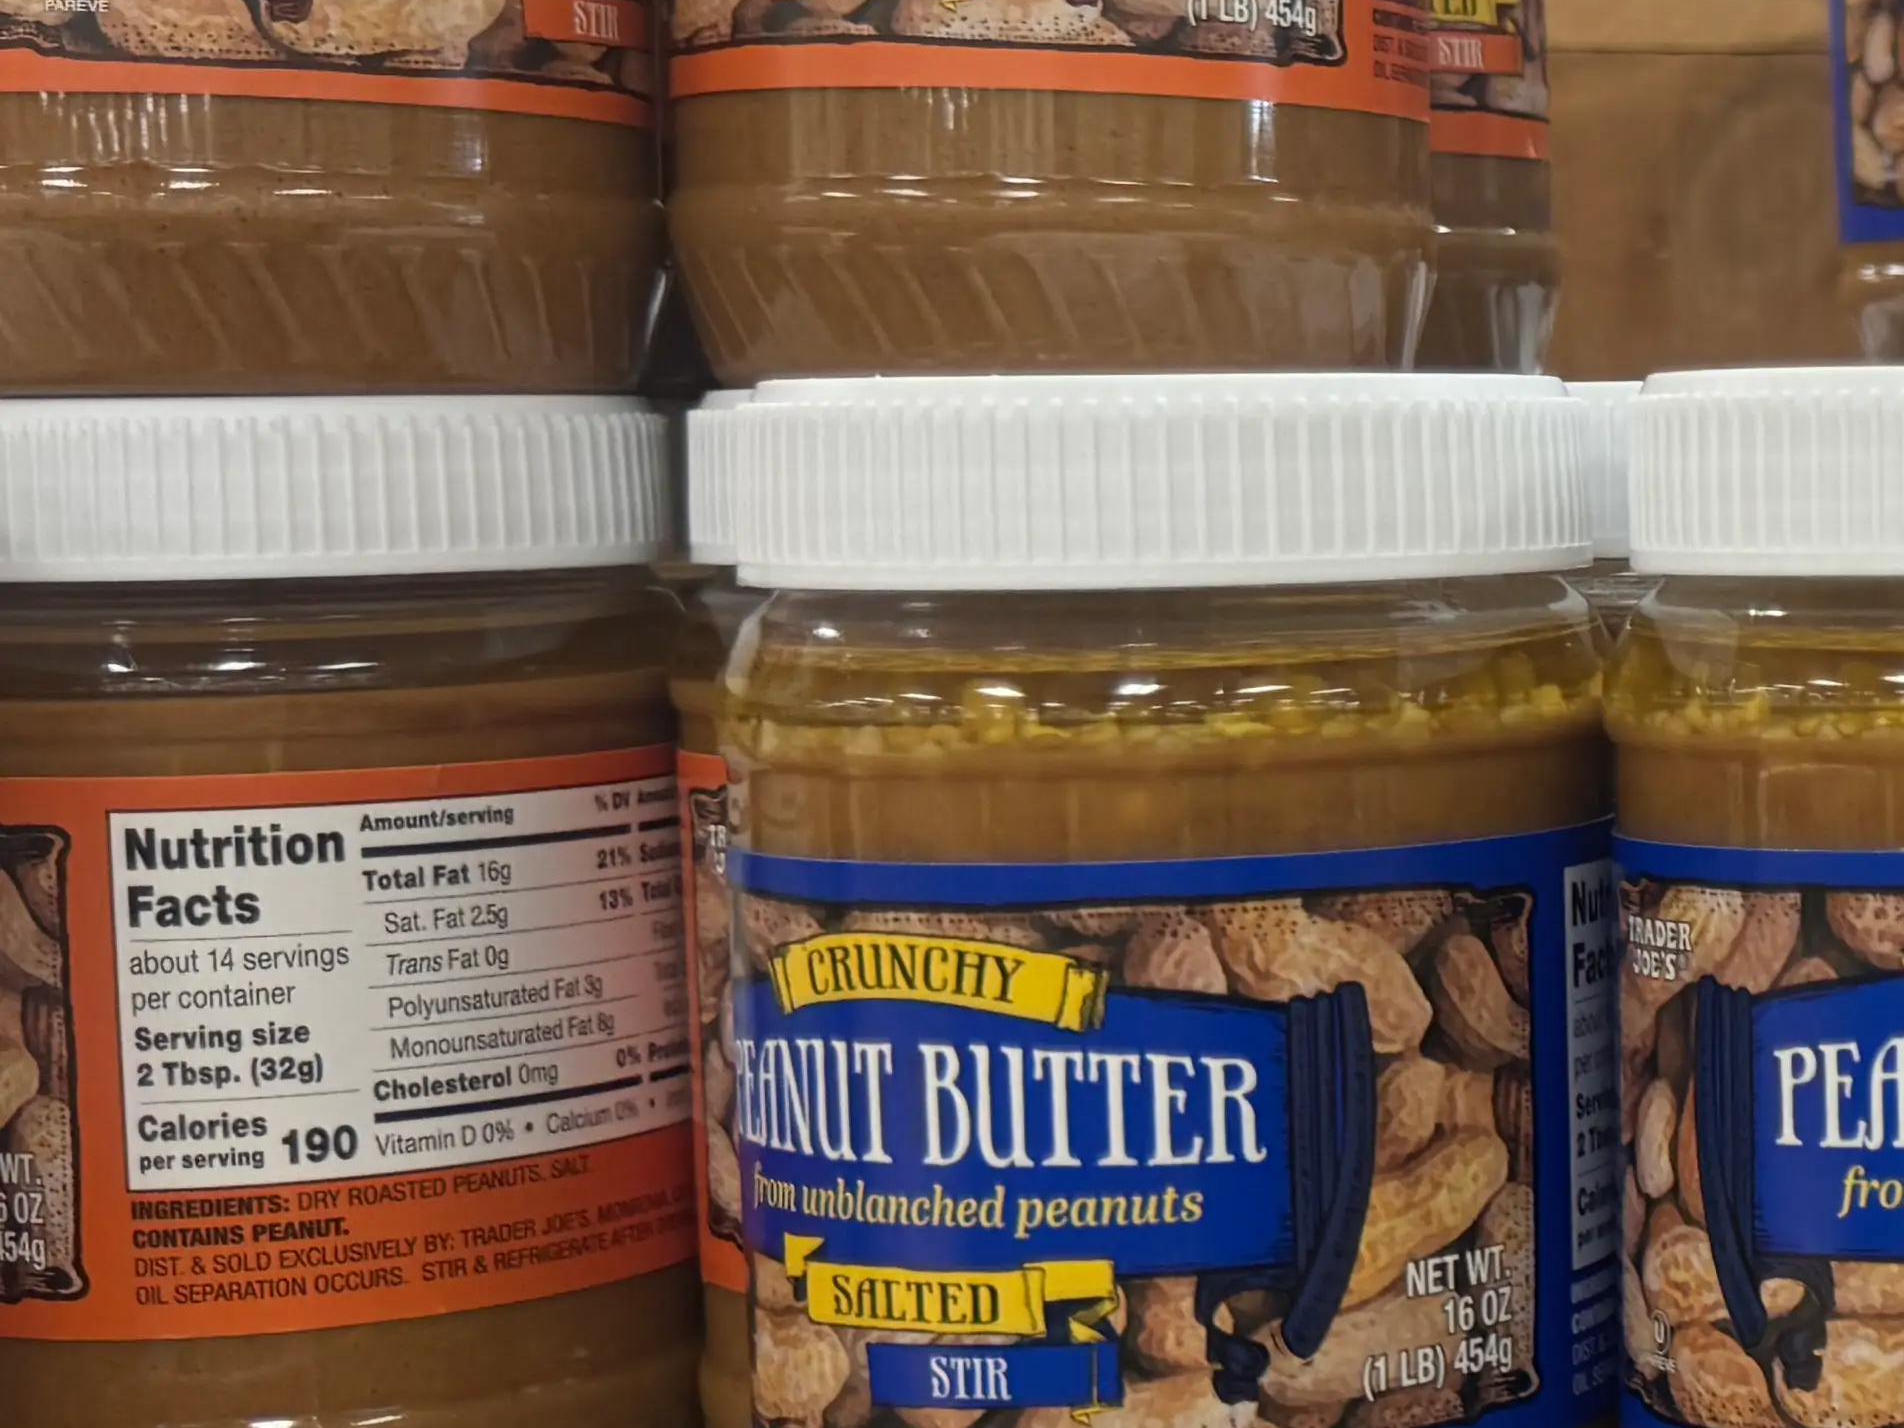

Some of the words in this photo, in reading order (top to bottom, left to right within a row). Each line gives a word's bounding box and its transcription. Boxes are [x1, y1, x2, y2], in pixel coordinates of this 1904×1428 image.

[571, 0, 620, 41] STIR
[359, 805, 515, 834] Amount/serving
[124, 827, 346, 872] Nutrition
[362, 863, 425, 891] Total
[432, 861, 470, 887] Fat
[477, 861, 512, 888] 16g
[127, 886, 261, 929] Facts
[1626, 916, 1692, 953] TRADER
[128, 946, 200, 977] about
[208, 947, 233, 972] 14
[243, 944, 350, 972] servings
[807, 944, 1025, 1005] CRUNCHY
[132, 988, 170, 1017] per
[177, 984, 296, 1011] container
[134, 1026, 243, 1054] Serving
[251, 1022, 311, 1046] size
[137, 1064, 154, 1087] 2
[161, 1059, 240, 1091] Tbsp.
[251, 1053, 323, 1085] (32g)
[373, 1065, 512, 1102] Cholesterol
[921, 1041, 1267, 1169] BUTTER
[138, 1111, 268, 1143] Calories
[281, 1125, 359, 1163] 190
[139, 1151, 175, 1173] per
[182, 1146, 265, 1170] serving
[801, 1178, 1006, 1230] unblanched
[1015, 1185, 1203, 1239] peanuts
[1407, 1255, 1459, 1297] NET
[1465, 1244, 1512, 1283] WT.
[831, 1274, 1001, 1327] SALTED
[1442, 1300, 1475, 1331] 16
[1481, 1293, 1513, 1326] OZ
[929, 1356, 1011, 1400] STIR
[1362, 1353, 1387, 1402] (1
[1396, 1345, 1446, 1390] LB)
[1453, 1338, 1514, 1378] 454g
